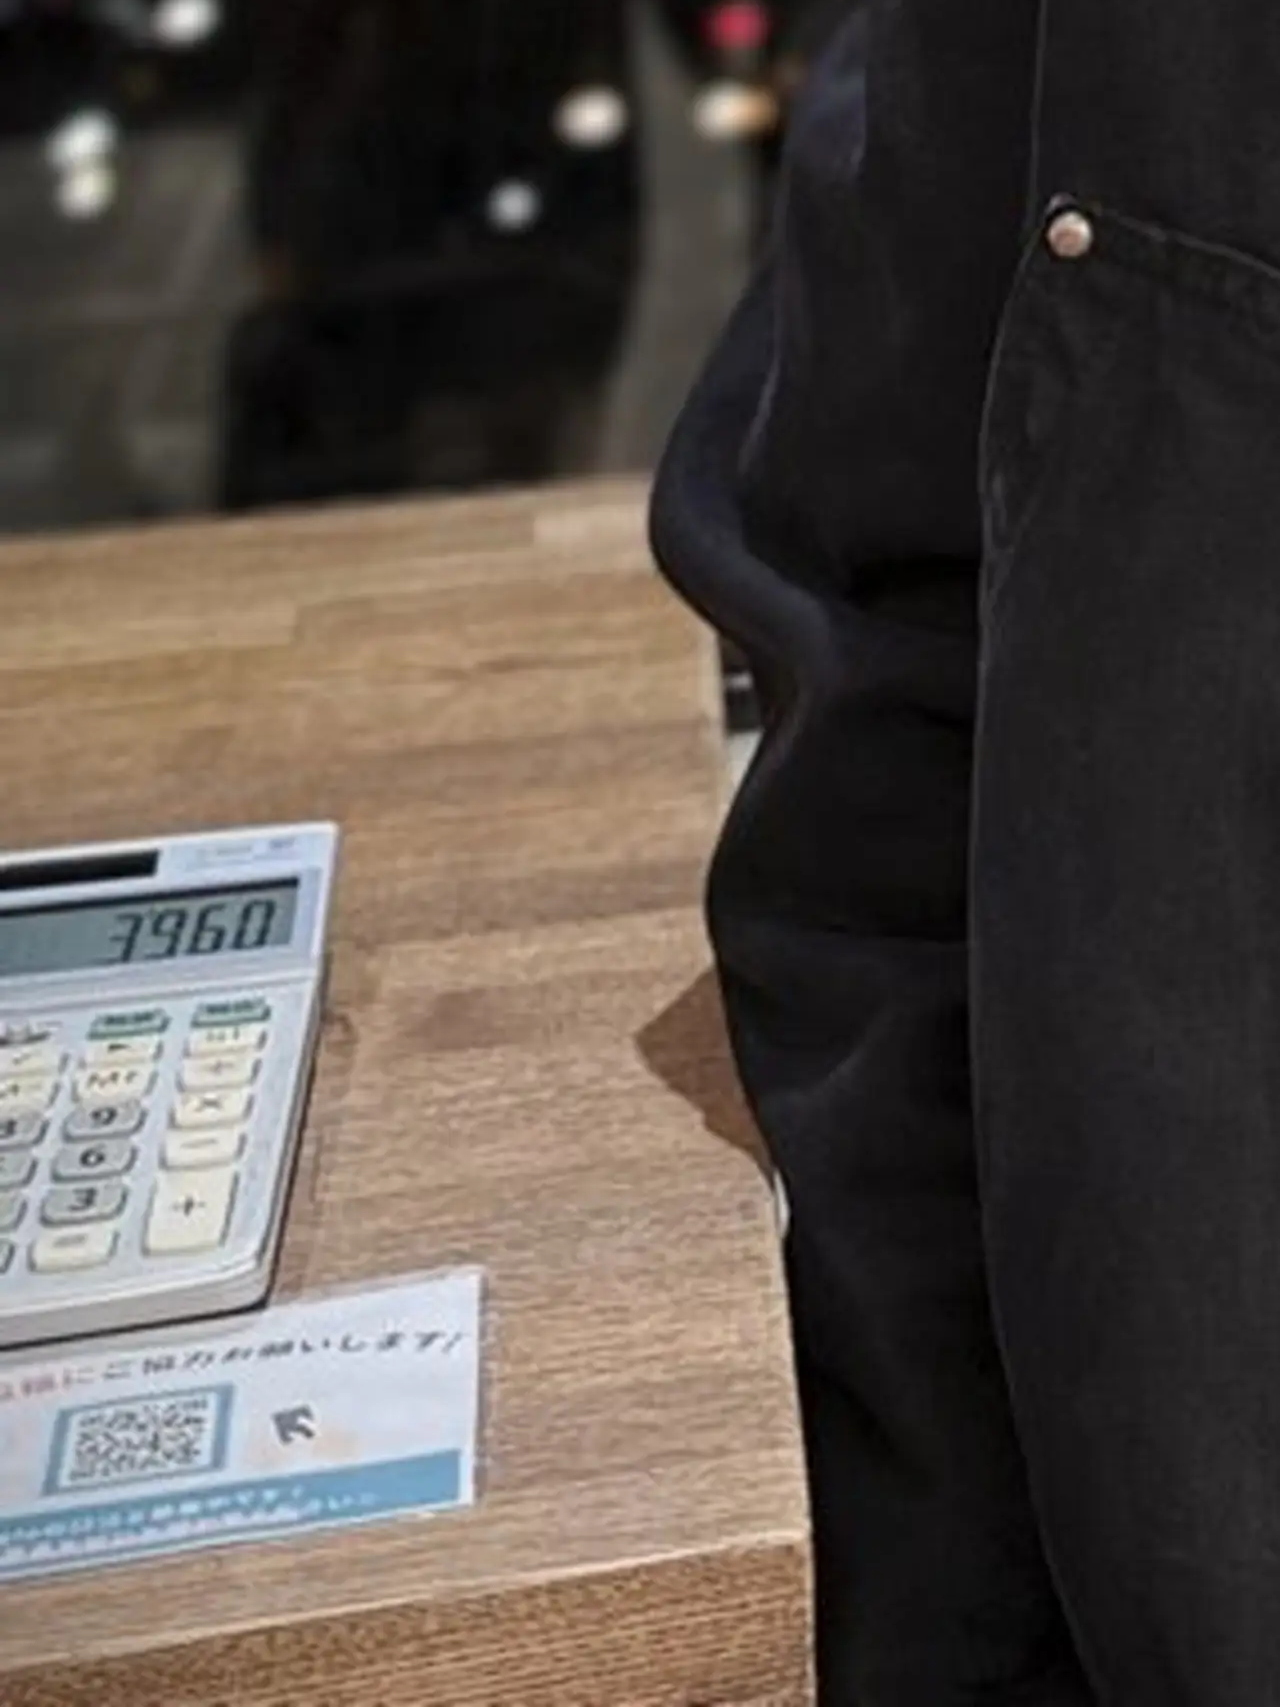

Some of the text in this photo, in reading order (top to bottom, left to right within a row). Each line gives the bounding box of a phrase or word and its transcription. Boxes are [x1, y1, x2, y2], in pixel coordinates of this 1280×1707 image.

[105, 898, 276, 963] 3960
[80, 1143, 105, 1168] 6
[68, 1187, 97, 1212] 3
